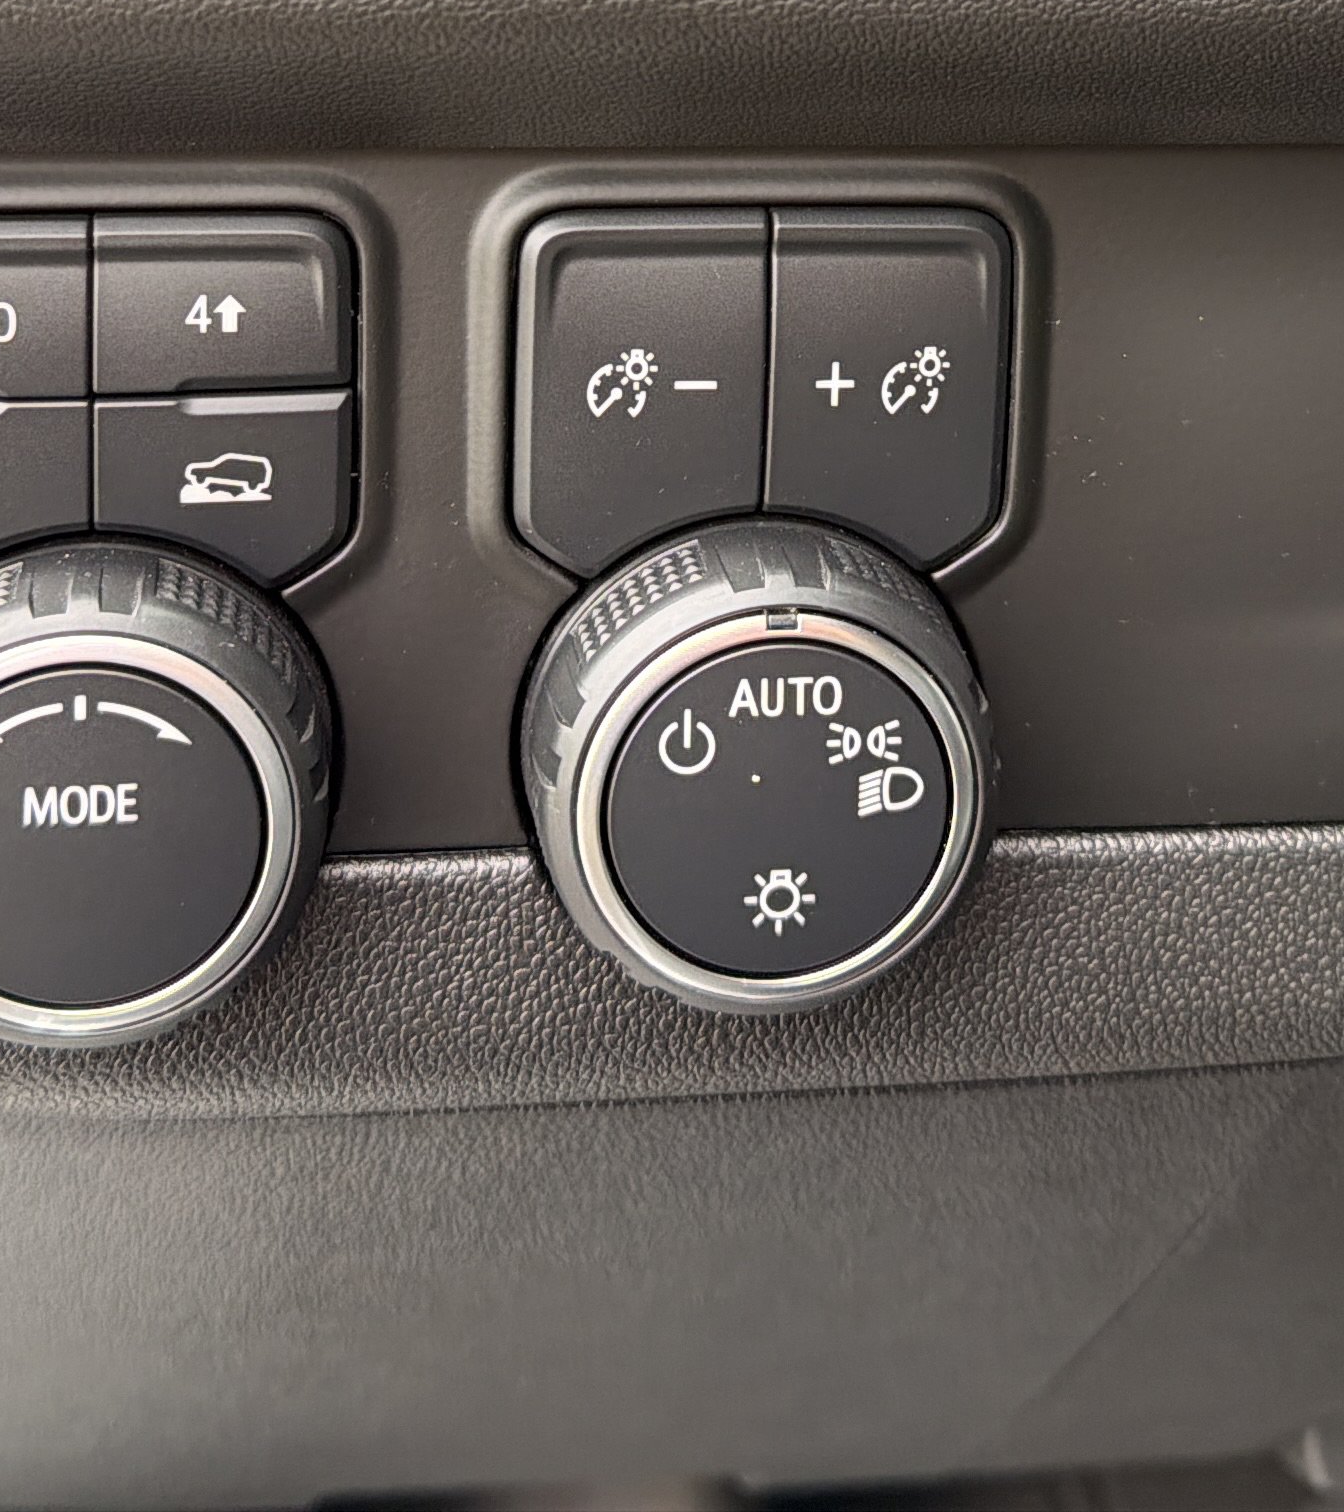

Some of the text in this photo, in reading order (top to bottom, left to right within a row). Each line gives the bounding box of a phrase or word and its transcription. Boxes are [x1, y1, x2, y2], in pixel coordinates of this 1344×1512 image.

[184, 294, 212, 334] 4
[729, 676, 843, 717] AUTO
[22, 783, 139, 827] MODE
